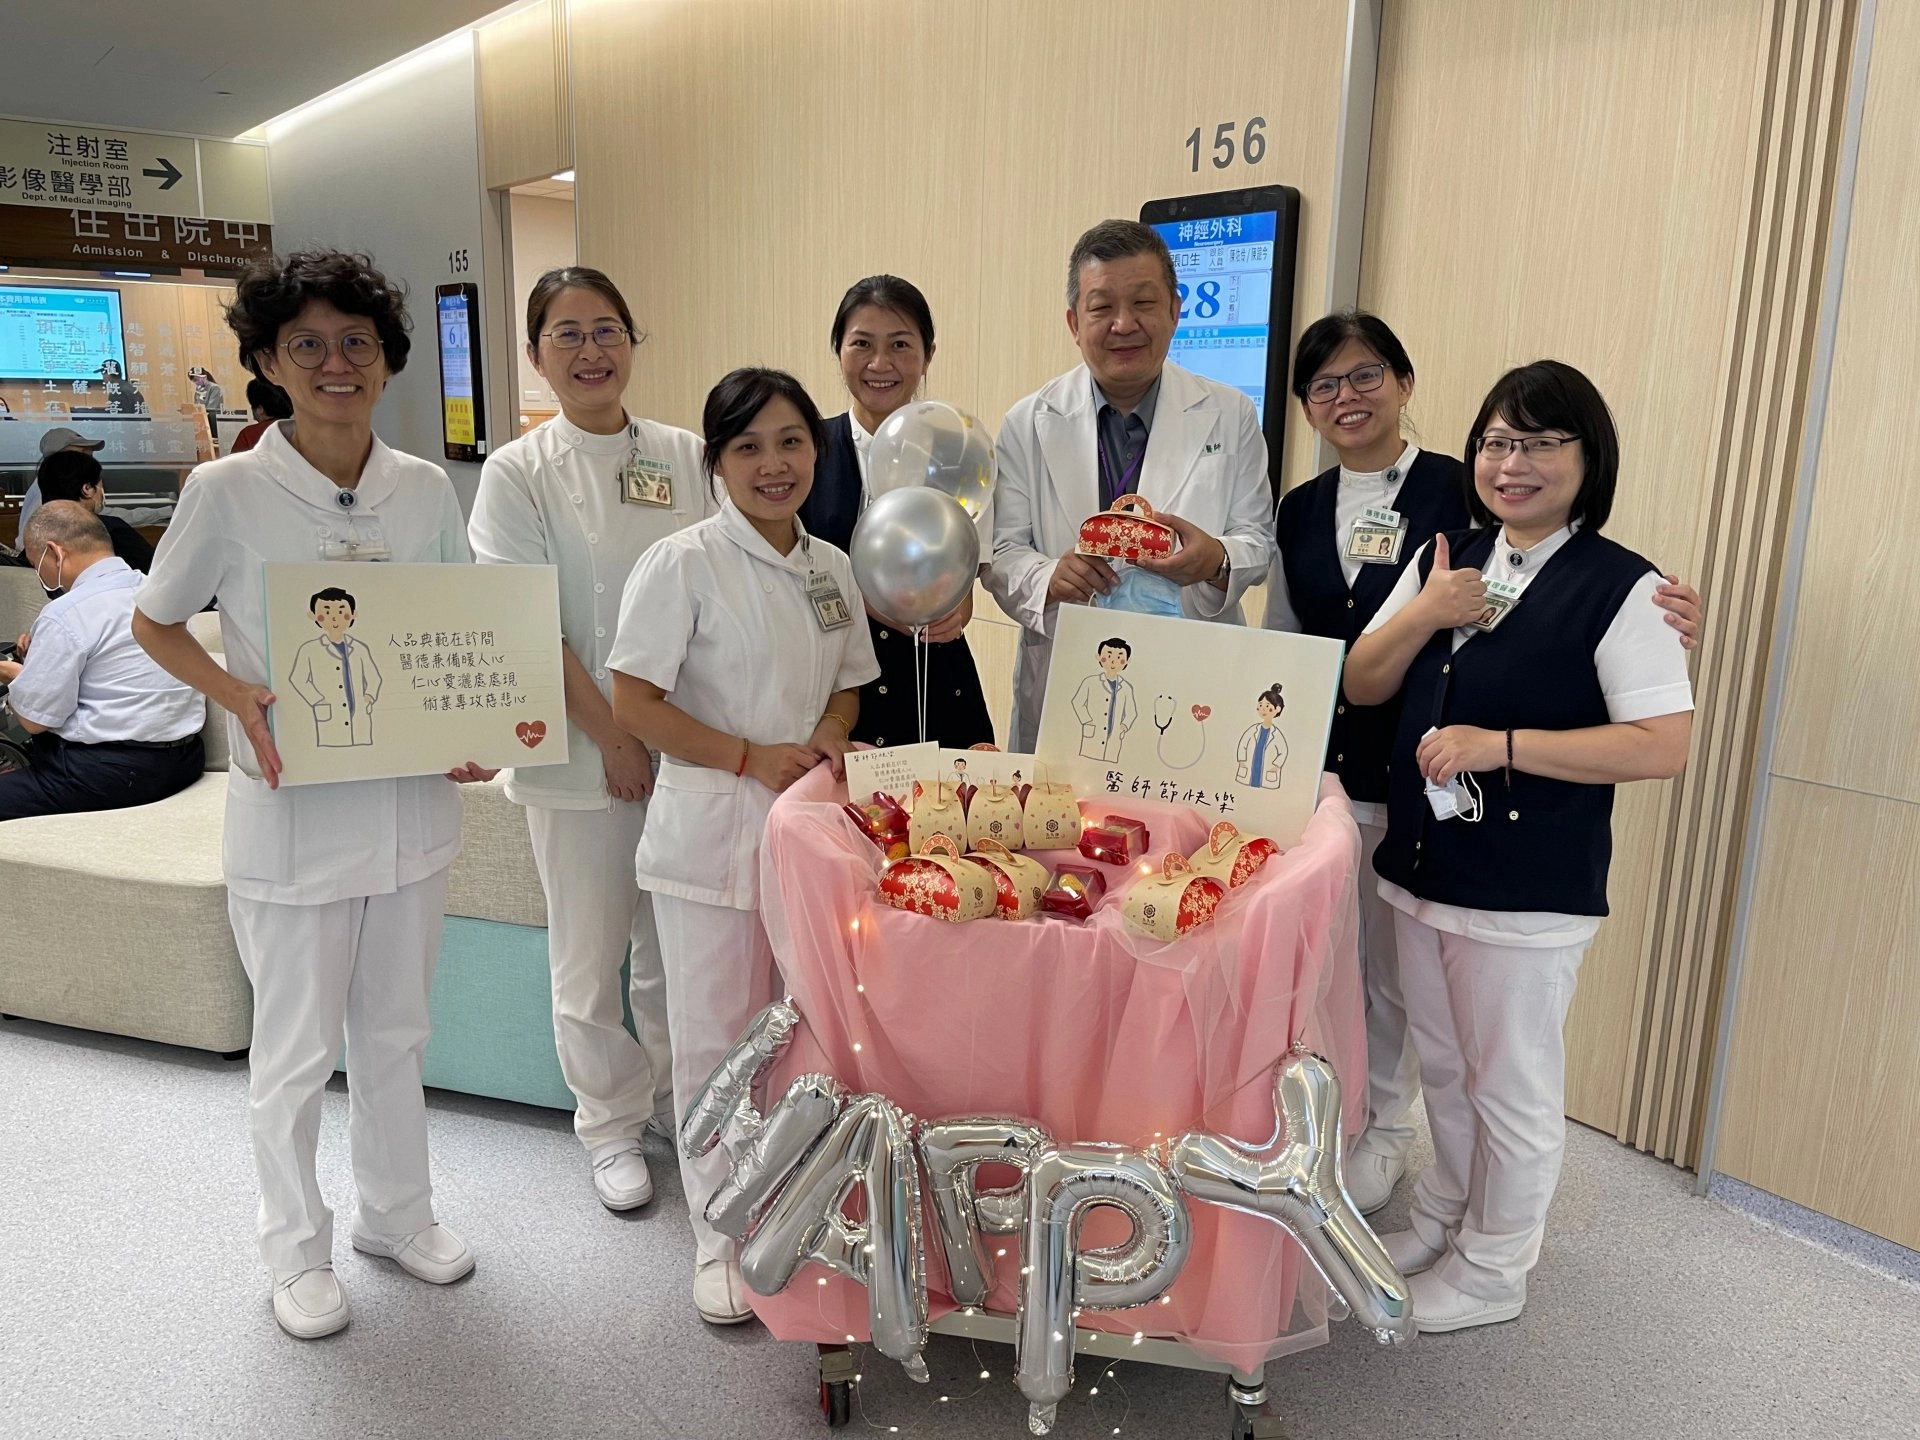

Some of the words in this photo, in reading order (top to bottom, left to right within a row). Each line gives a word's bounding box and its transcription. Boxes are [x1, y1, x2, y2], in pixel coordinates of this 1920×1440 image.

[47, 133, 129, 161] 注射室
[1185, 117, 1267, 173] 156
[61, 158, 100, 169] Injection
[103, 161, 129, 171] Room
[0, 166, 131, 198] 影像醫學部
[22, 192, 47, 202] Dept.
[49, 194, 58, 202] of
[60, 194, 95, 205] Medical
[97, 197, 132, 209] Imaging
[1178, 216, 1242, 242] 神經外科
[72, 243, 143, 258] Admission
[161, 250, 170, 260] &
[188, 251, 251, 267] Discharge
[448, 249, 470, 274] 155
[1179, 281, 1221, 319] 28
[449, 326, 456, 345] 6
[388, 631, 494, 647] 人品典範在診間
[400, 652, 505, 670] 醫德兼備暖人心
[412, 672, 518, 690] 仁心愛灑處處現
[423, 692, 527, 711] 術業專攻慈悲心
[1106, 771, 1235, 812] 醫師節快樂
